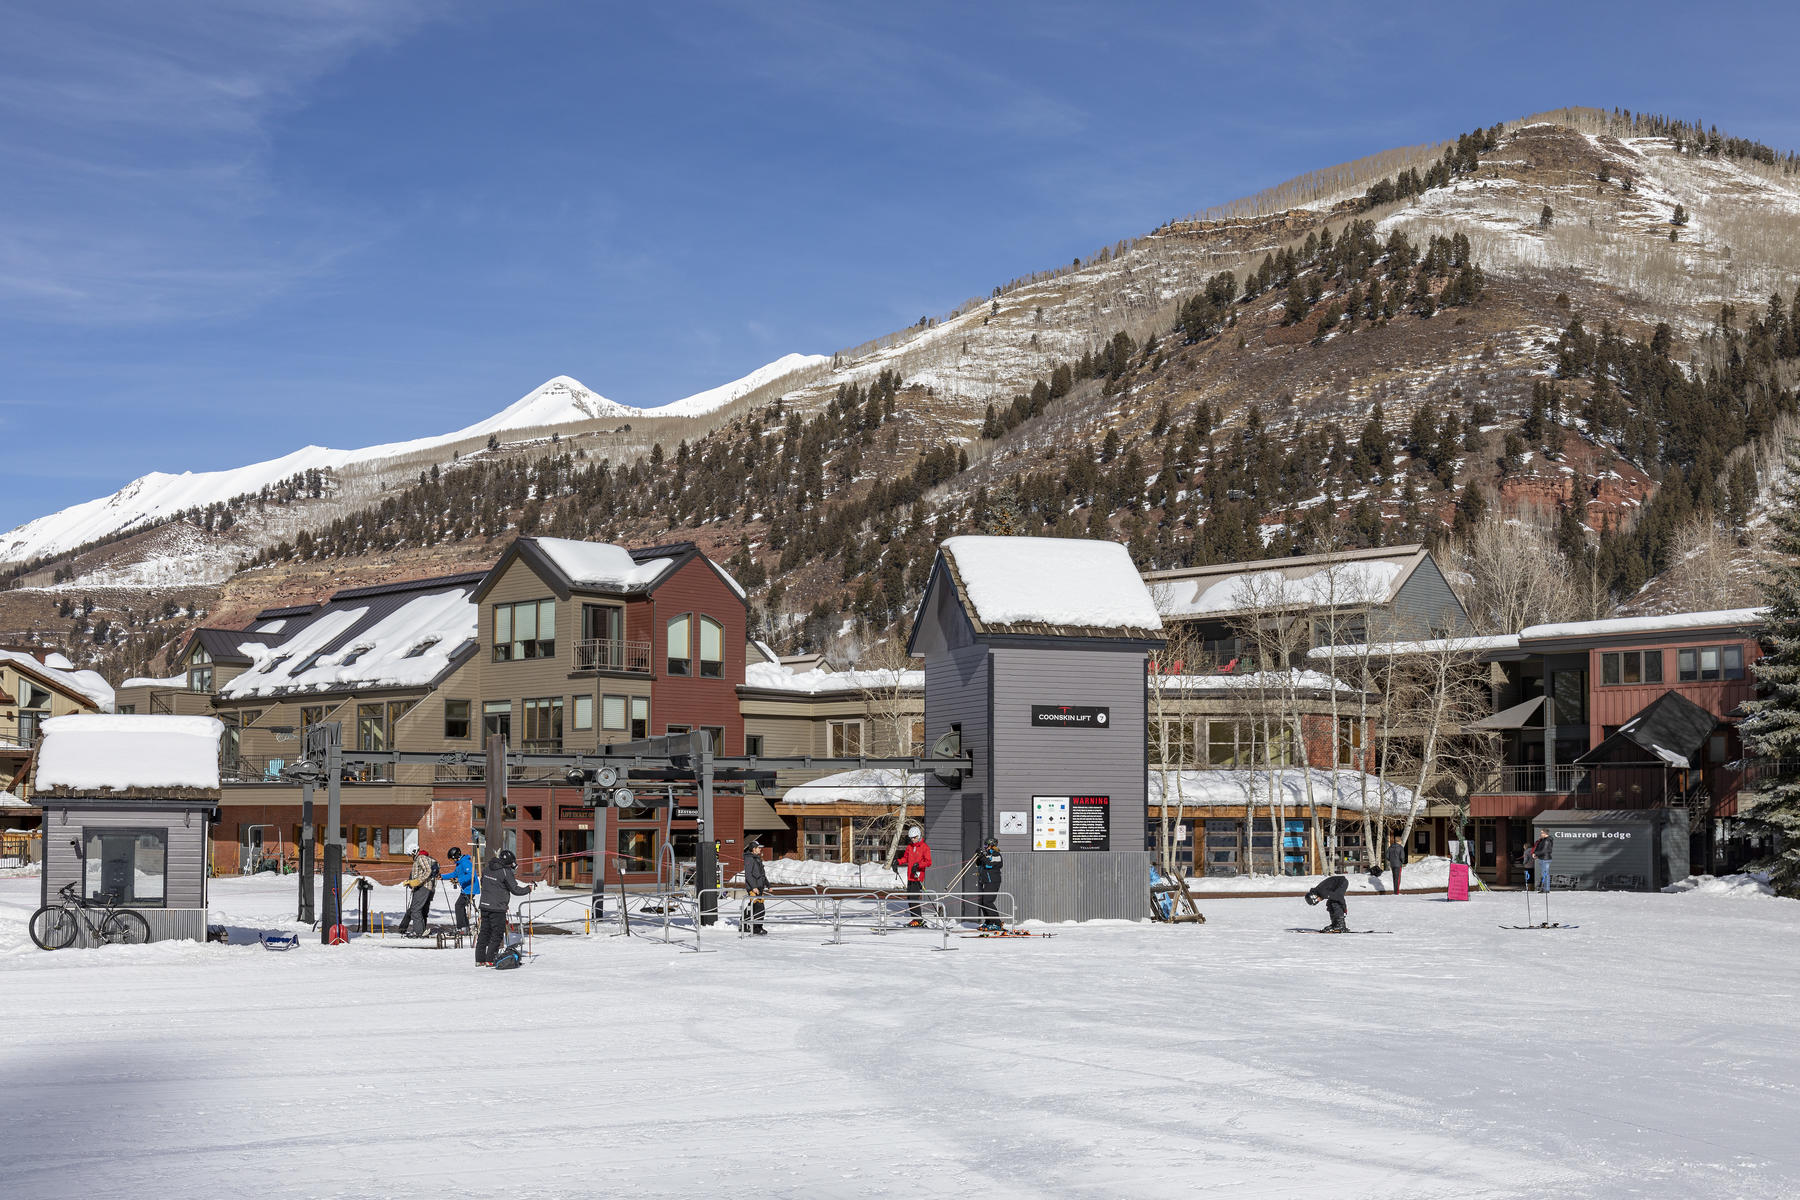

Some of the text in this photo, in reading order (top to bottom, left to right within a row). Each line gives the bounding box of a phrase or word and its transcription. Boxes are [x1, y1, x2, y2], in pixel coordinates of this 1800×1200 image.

[1038, 713, 1076, 721] COONSKIN
[1072, 797, 1109, 805] WARNING
[1601, 831, 1632, 840] Lodge
